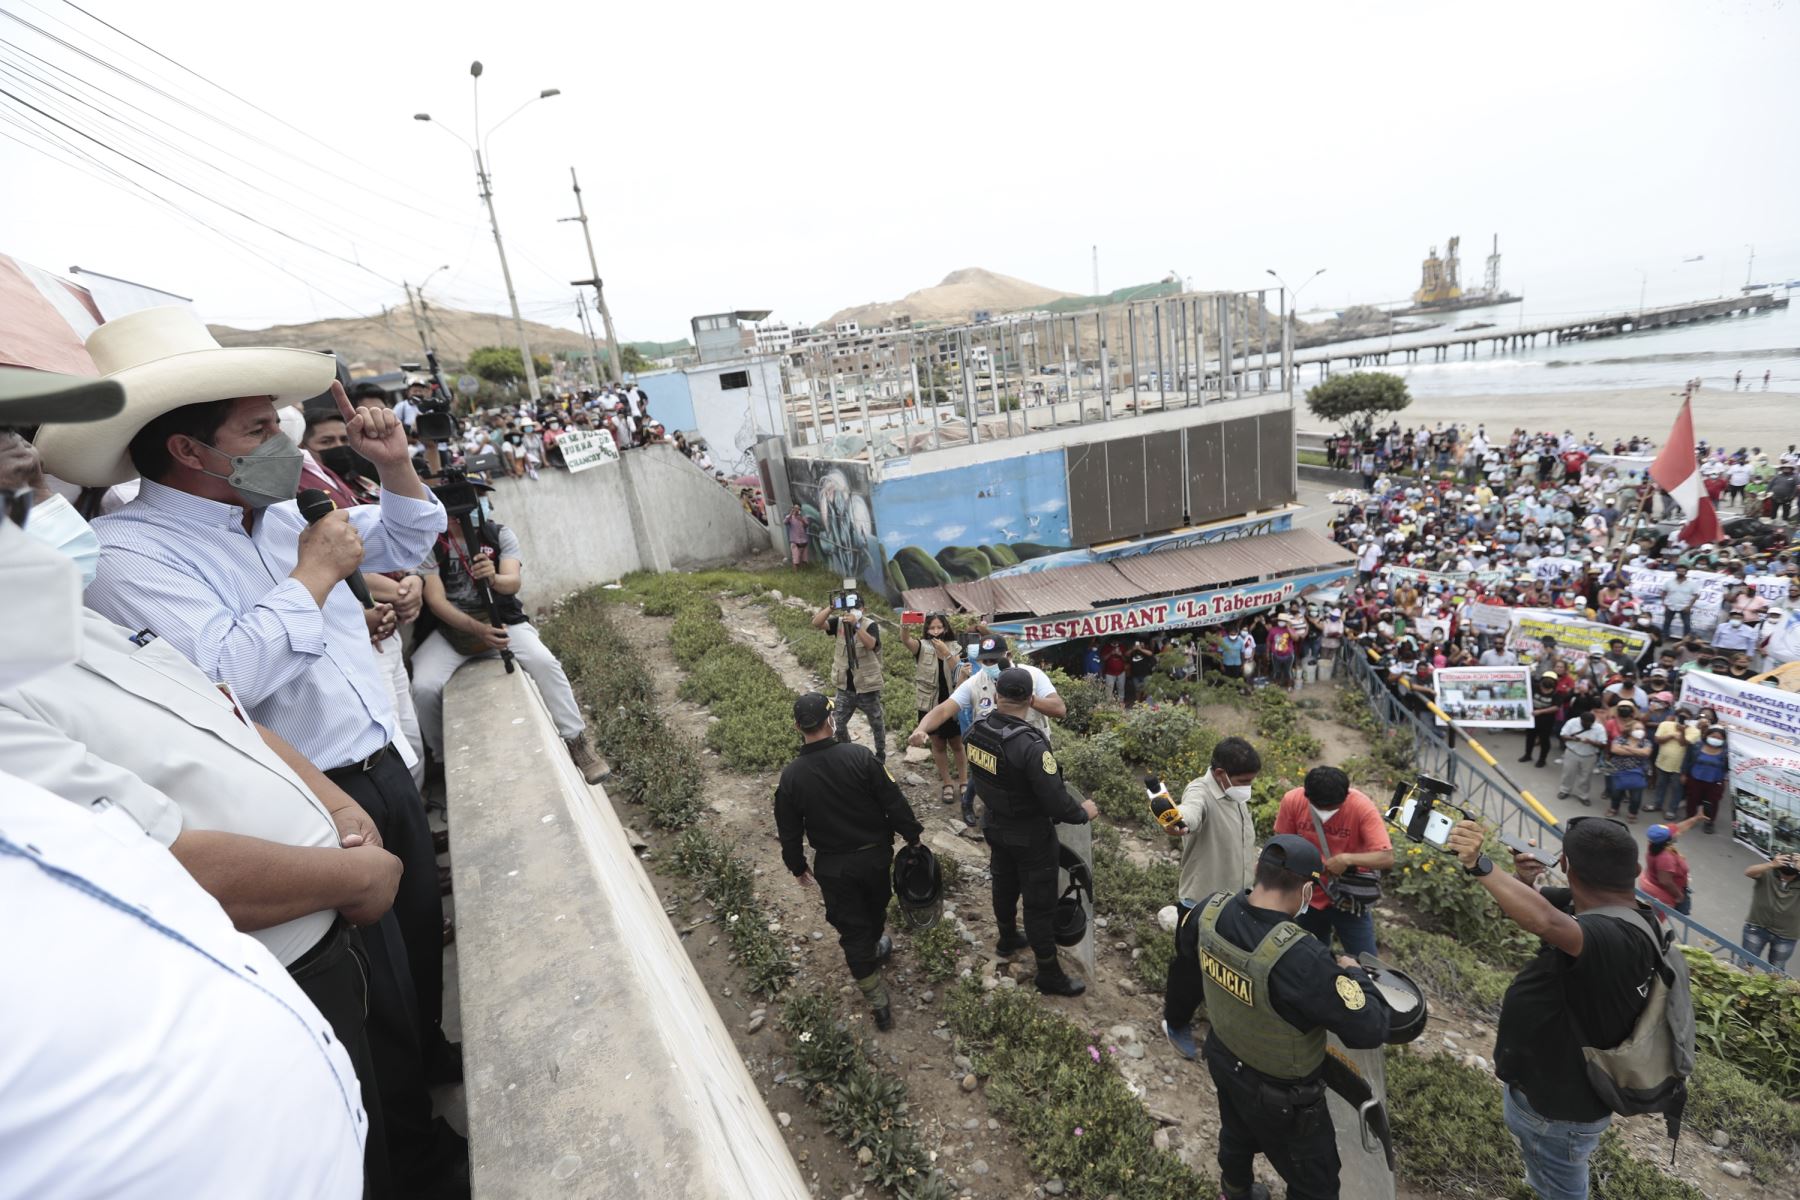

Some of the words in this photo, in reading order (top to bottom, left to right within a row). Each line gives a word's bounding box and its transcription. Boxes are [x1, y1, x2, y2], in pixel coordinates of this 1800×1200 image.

[1025, 605, 1168, 641] RESTAURANT
[1212, 585, 1294, 614] Taberna”
[967, 745, 995, 772] POLICIA
[1202, 955, 1251, 1003] POLICIA
